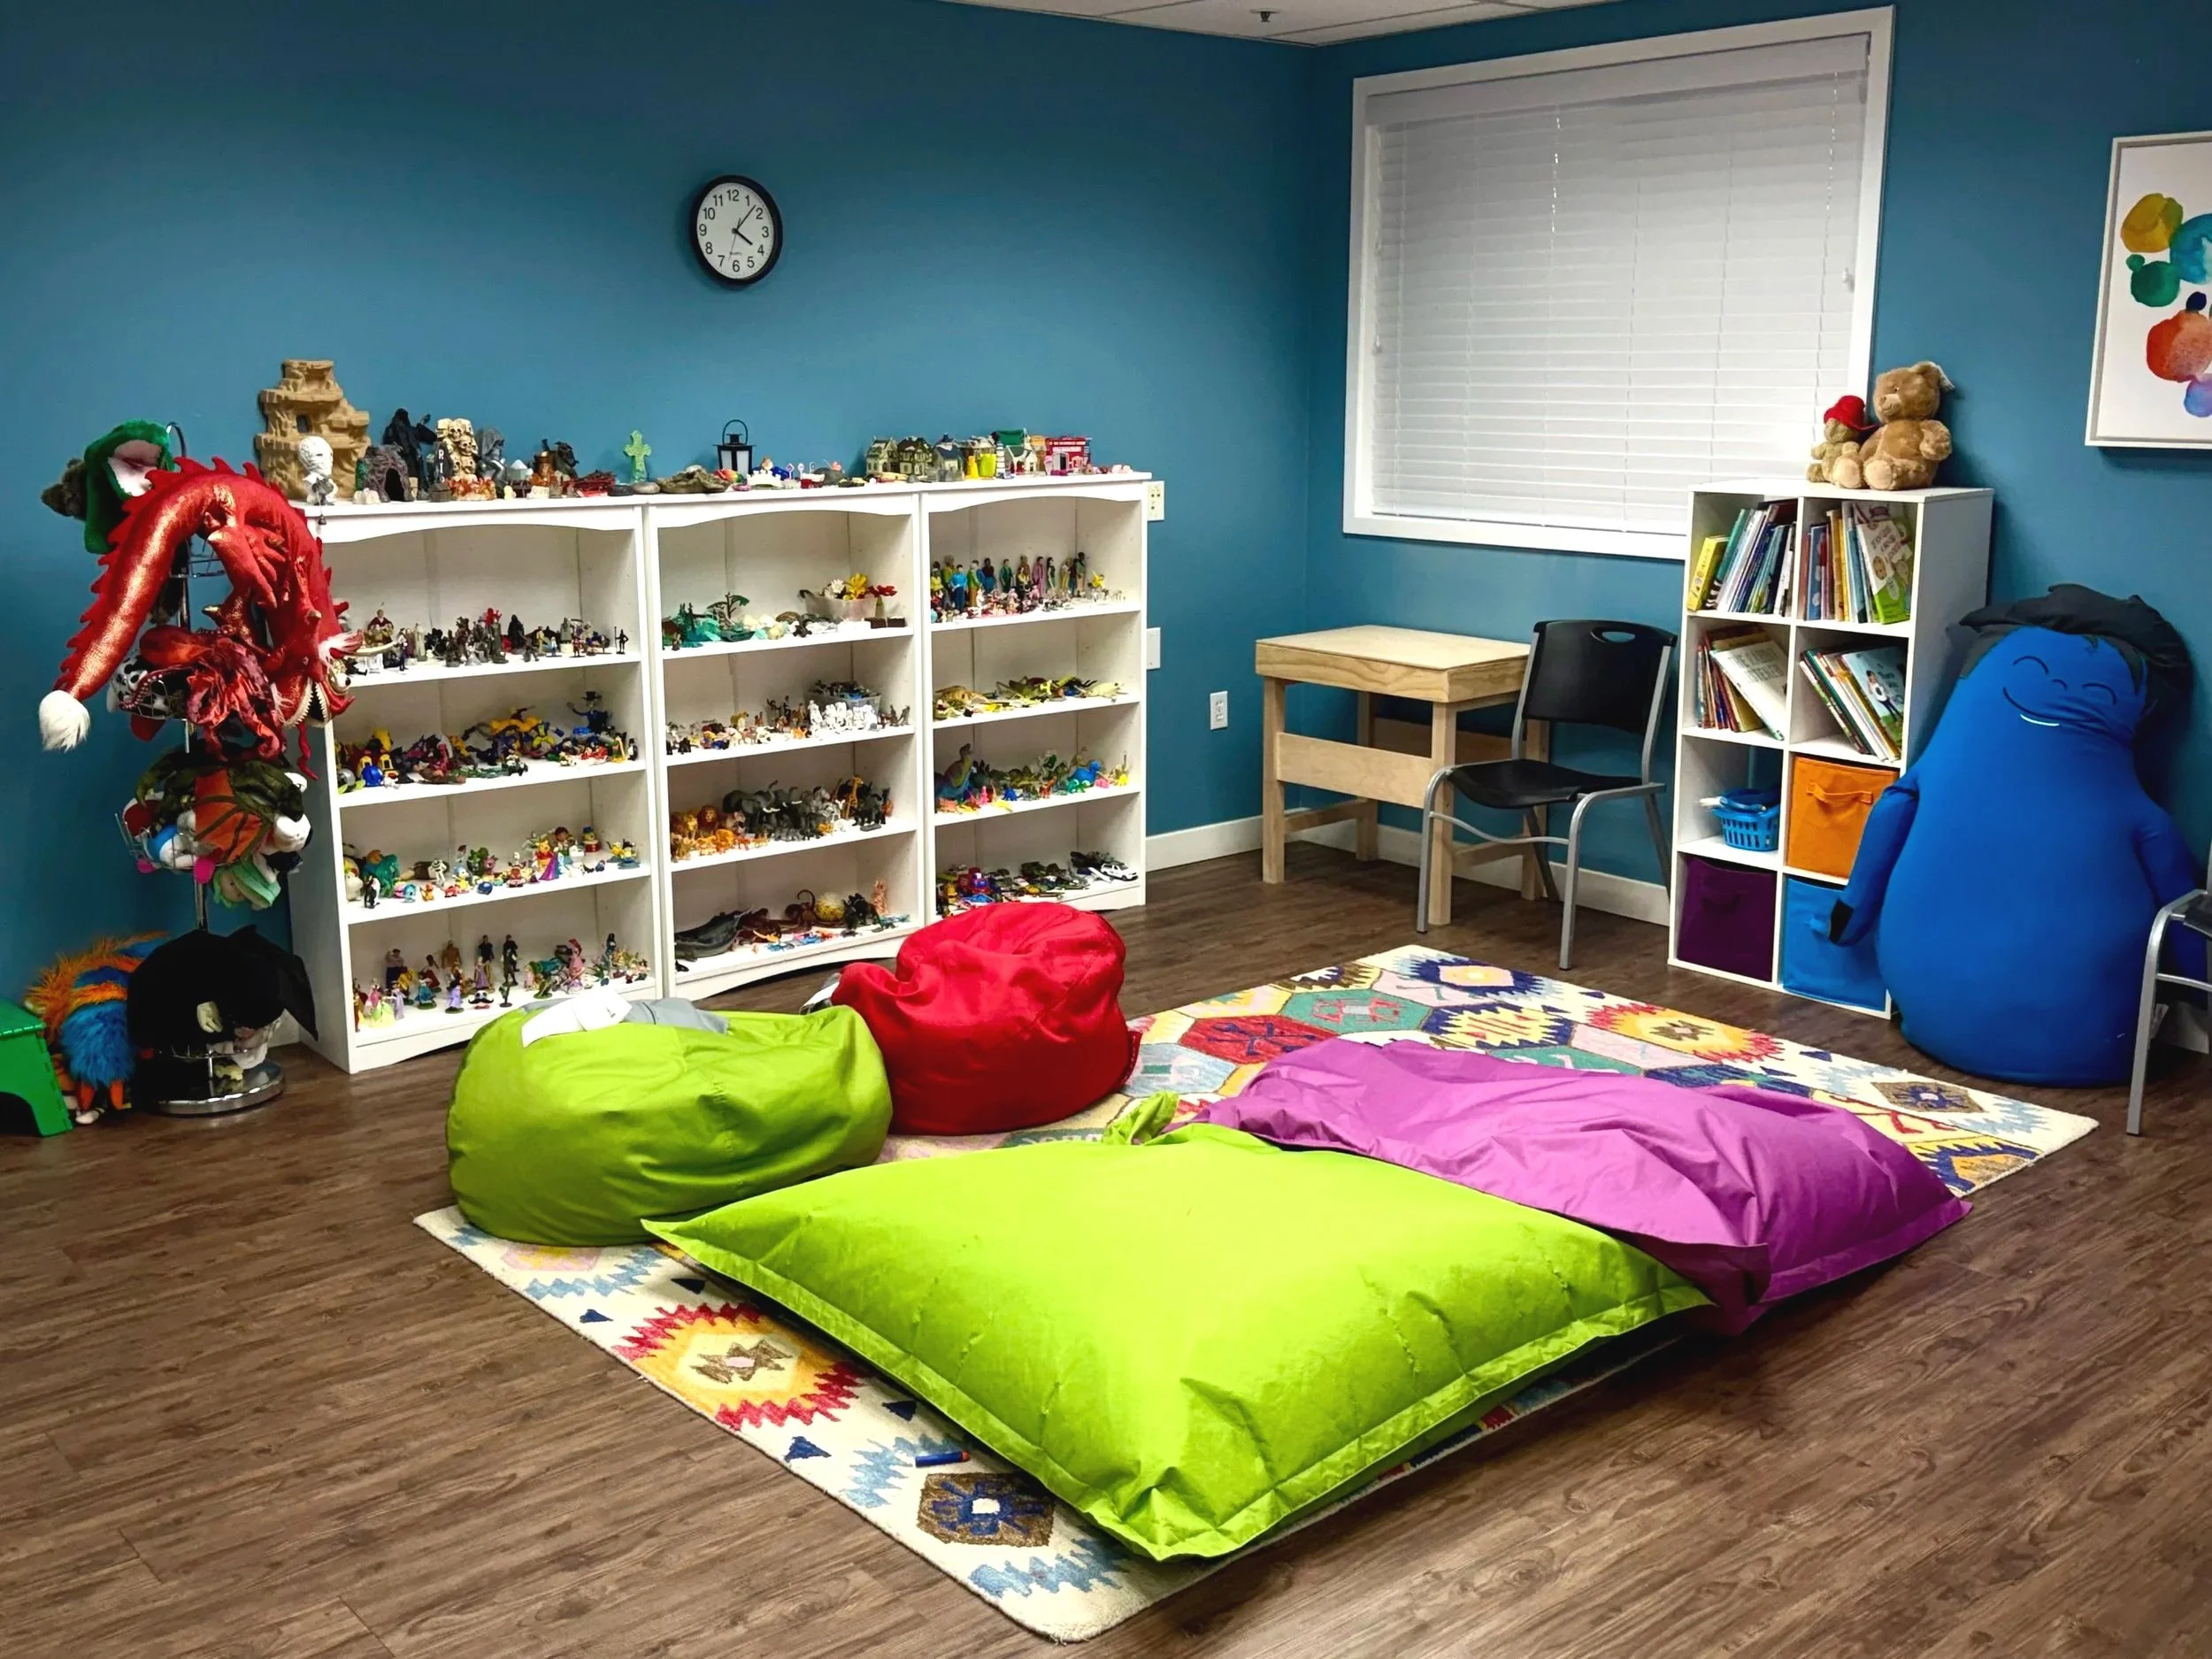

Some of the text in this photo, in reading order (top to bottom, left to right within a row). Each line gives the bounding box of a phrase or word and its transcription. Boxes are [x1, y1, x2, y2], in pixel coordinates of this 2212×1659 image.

[713, 194, 723, 207] 11
[726, 188, 740, 202] 12
[745, 195, 750, 206] 1
[703, 207, 716, 220] 10
[756, 207, 763, 219] 2
[699, 224, 707, 236] 9
[762, 226, 769, 238] 3
[705, 242, 713, 254] 8
[757, 243, 764, 256] 4
[718, 255, 725, 266] 7
[732, 260, 740, 273] 6
[747, 256, 755, 268] 5
